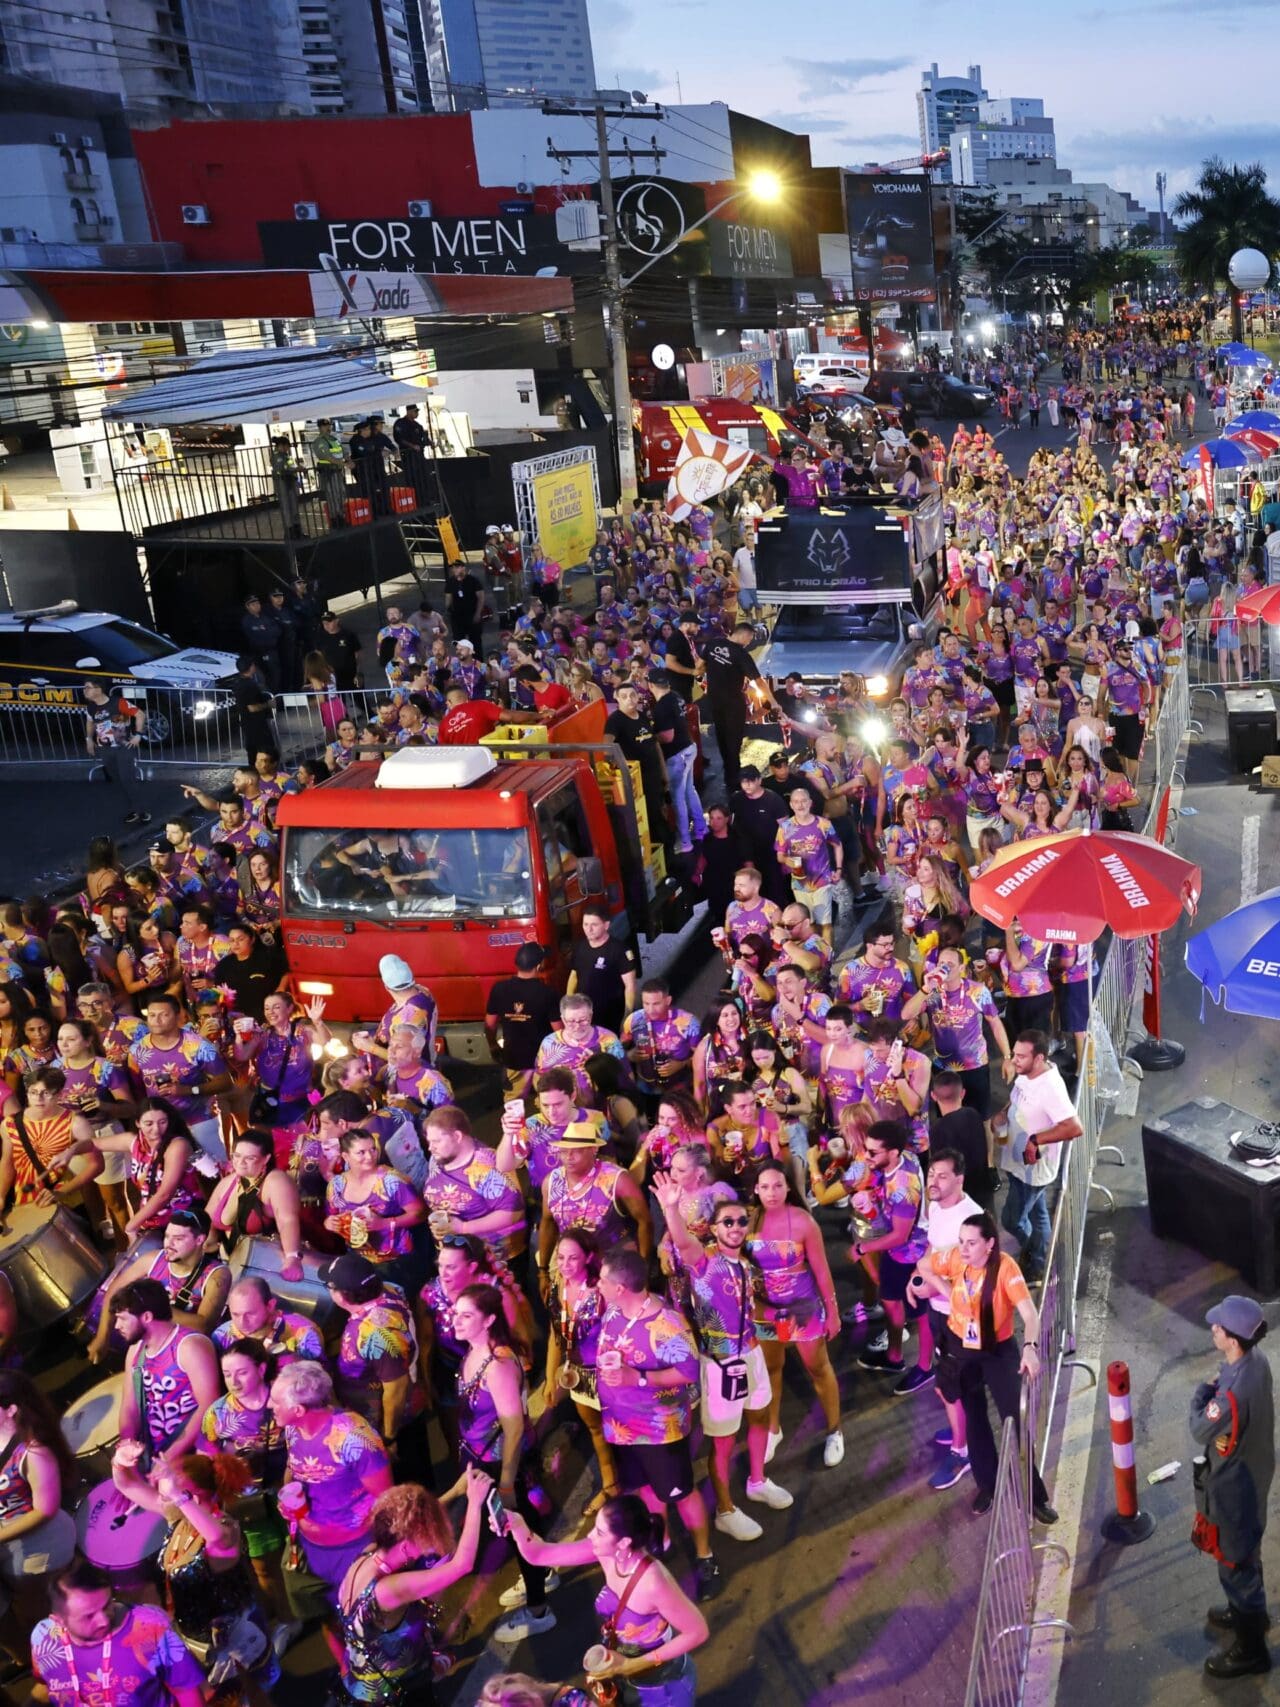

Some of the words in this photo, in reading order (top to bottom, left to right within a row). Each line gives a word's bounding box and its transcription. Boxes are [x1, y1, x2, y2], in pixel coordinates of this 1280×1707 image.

[872, 183, 922, 194] YOKOHAMA
[328, 221, 415, 260] FOR
[431, 219, 527, 257] MEN
[727, 225, 750, 260] FOR
[754, 228, 777, 259] MEN
[792, 578, 821, 587] TRIO
[994, 849, 1061, 898] BRAHMA
[1100, 853, 1150, 909] BRAHMA
[287, 931, 348, 948] CARGO
[1045, 928, 1077, 941] BRAHMA
